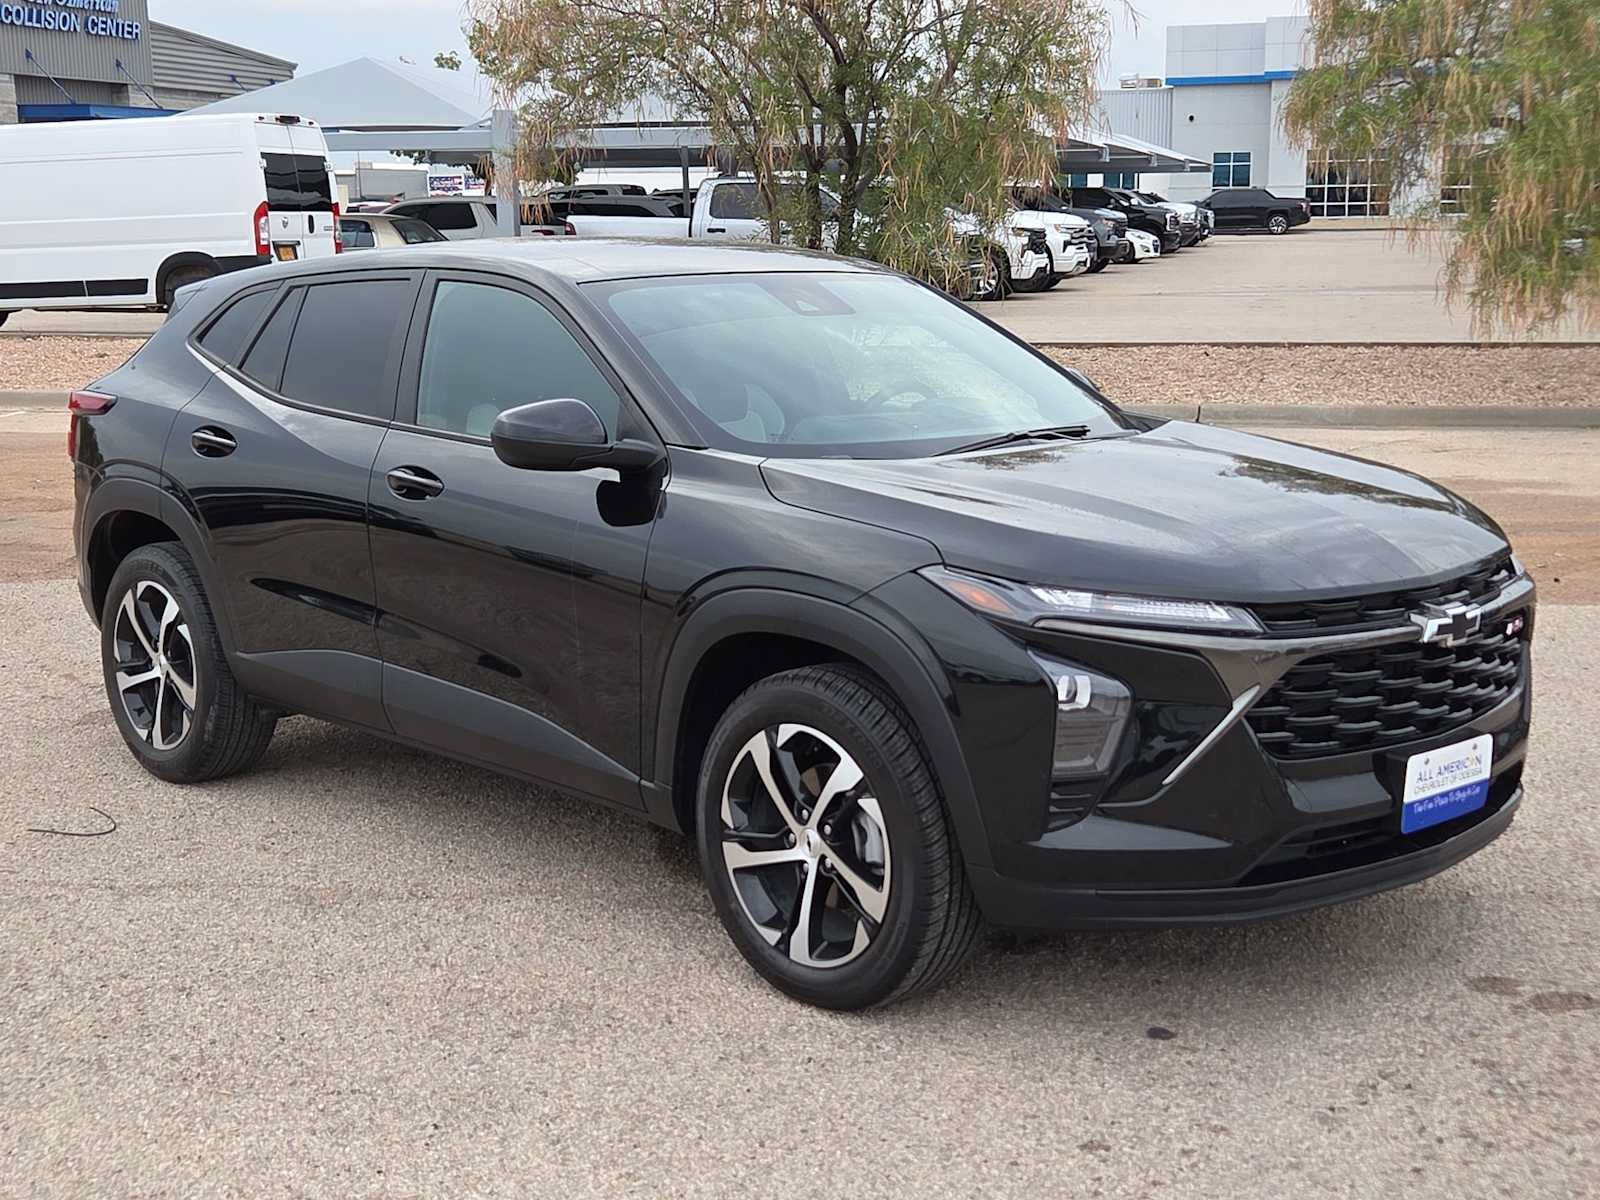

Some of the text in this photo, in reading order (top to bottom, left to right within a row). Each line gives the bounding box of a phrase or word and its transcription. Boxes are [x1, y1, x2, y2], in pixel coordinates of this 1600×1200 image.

[1, 4, 140, 40] COLLISION CENTER
[1416, 769, 1433, 784] ALL
